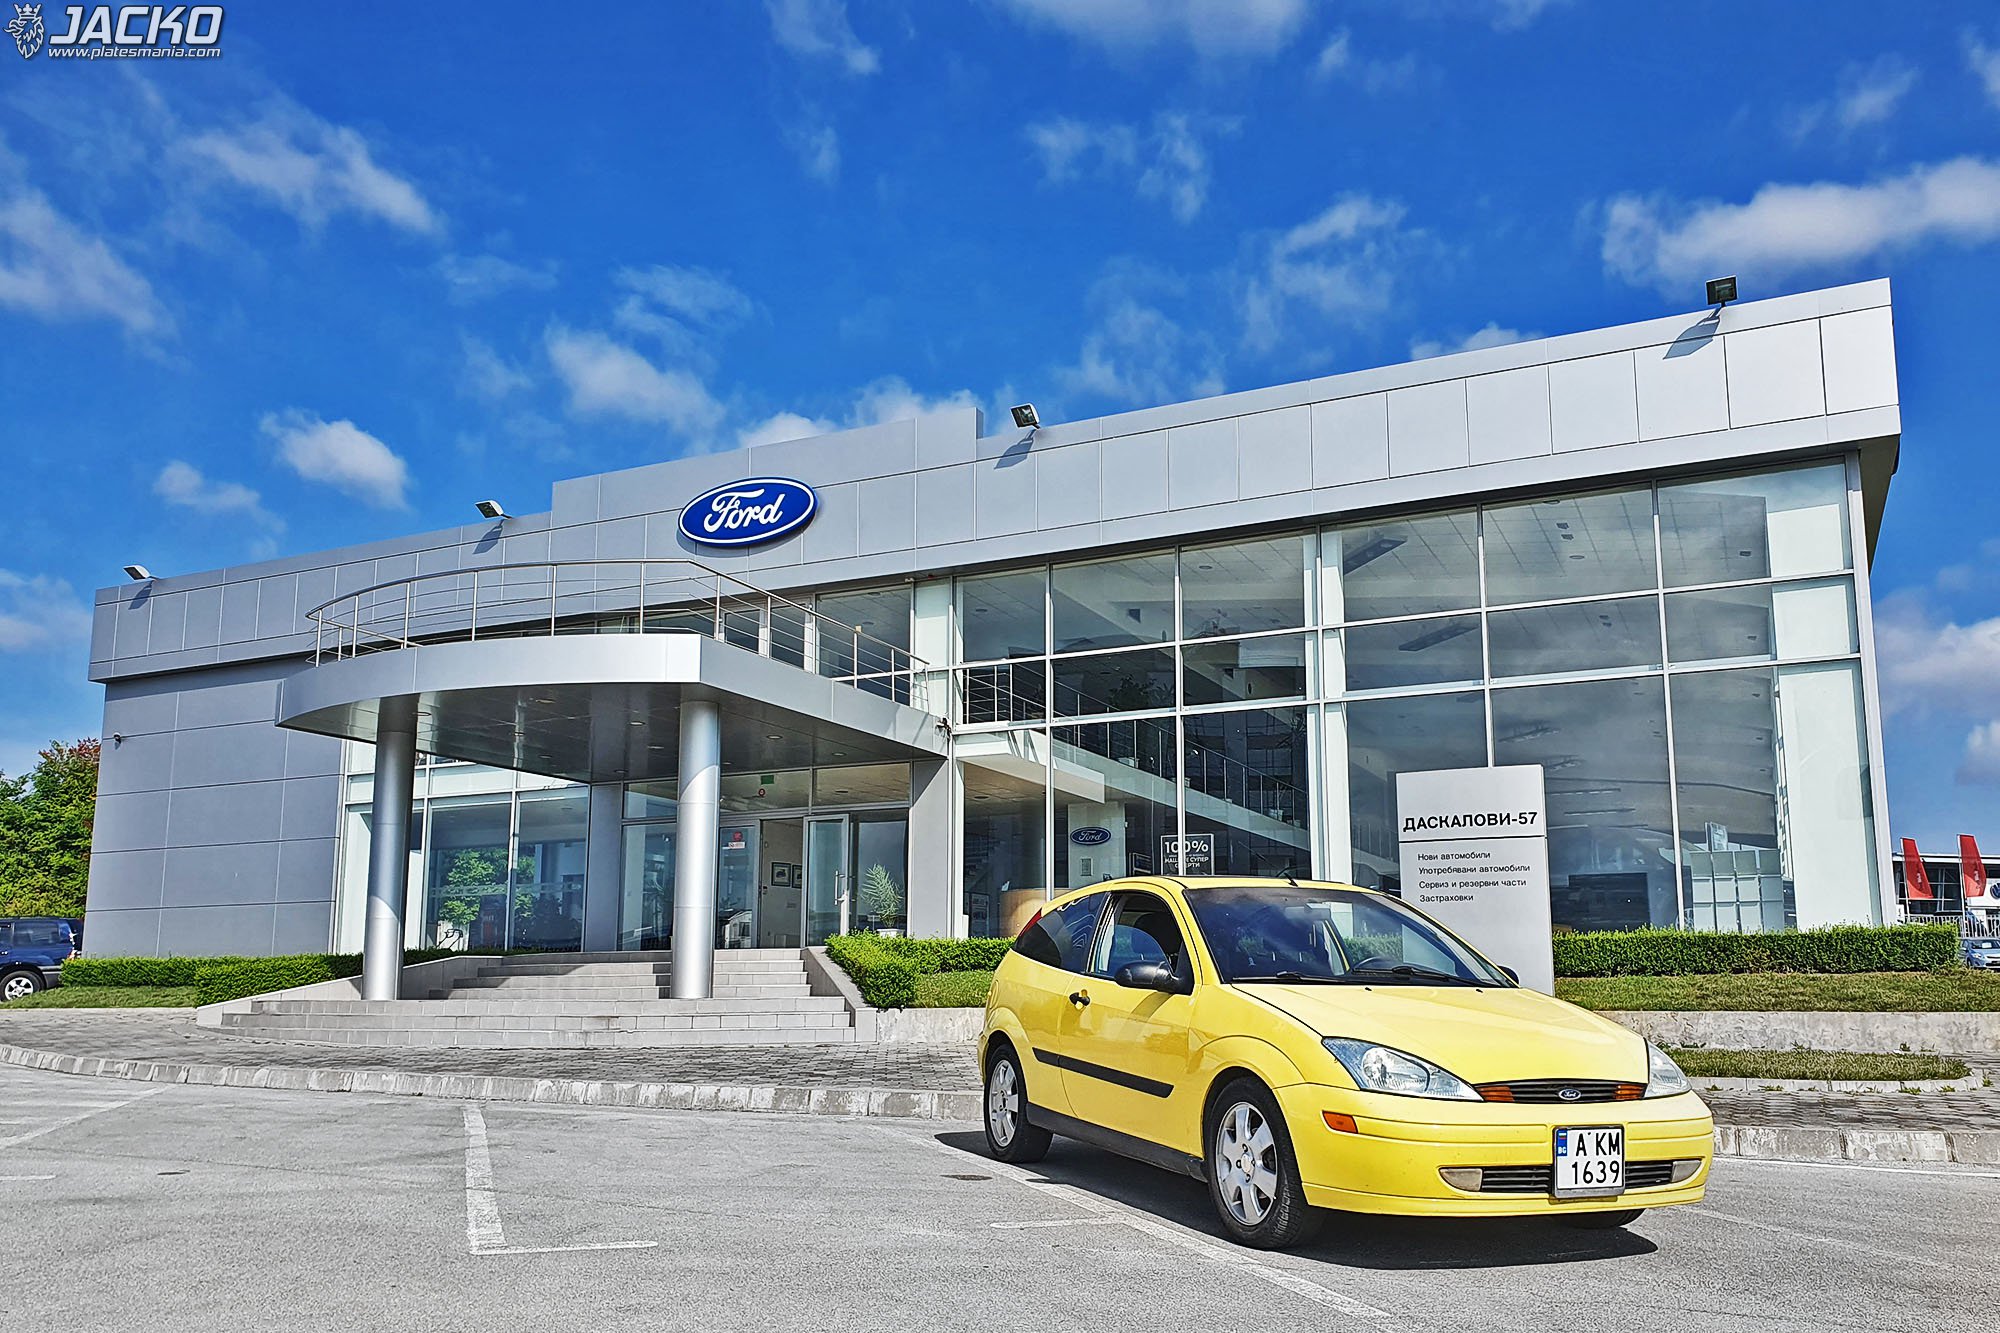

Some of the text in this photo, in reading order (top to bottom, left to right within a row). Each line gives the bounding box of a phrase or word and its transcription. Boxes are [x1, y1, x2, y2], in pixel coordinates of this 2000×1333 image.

[703, 488, 786, 533] Ford
[1402, 811, 1538, 833] ДАСКАЛОВИ-57
[1417, 852, 1491, 861] Нови автомобили
[1418, 864, 1531, 876] Употребявани автомобили
[1418, 880, 1449, 890] Сервиз
[1459, 880, 1499, 889] резервни
[1501, 879, 1527, 887] части
[1419, 894, 1474, 904] Застраховки
[1595, 1132, 1620, 1156] KM
[1557, 1146, 1567, 1155] BG
[1571, 1160, 1620, 1185] 1639
